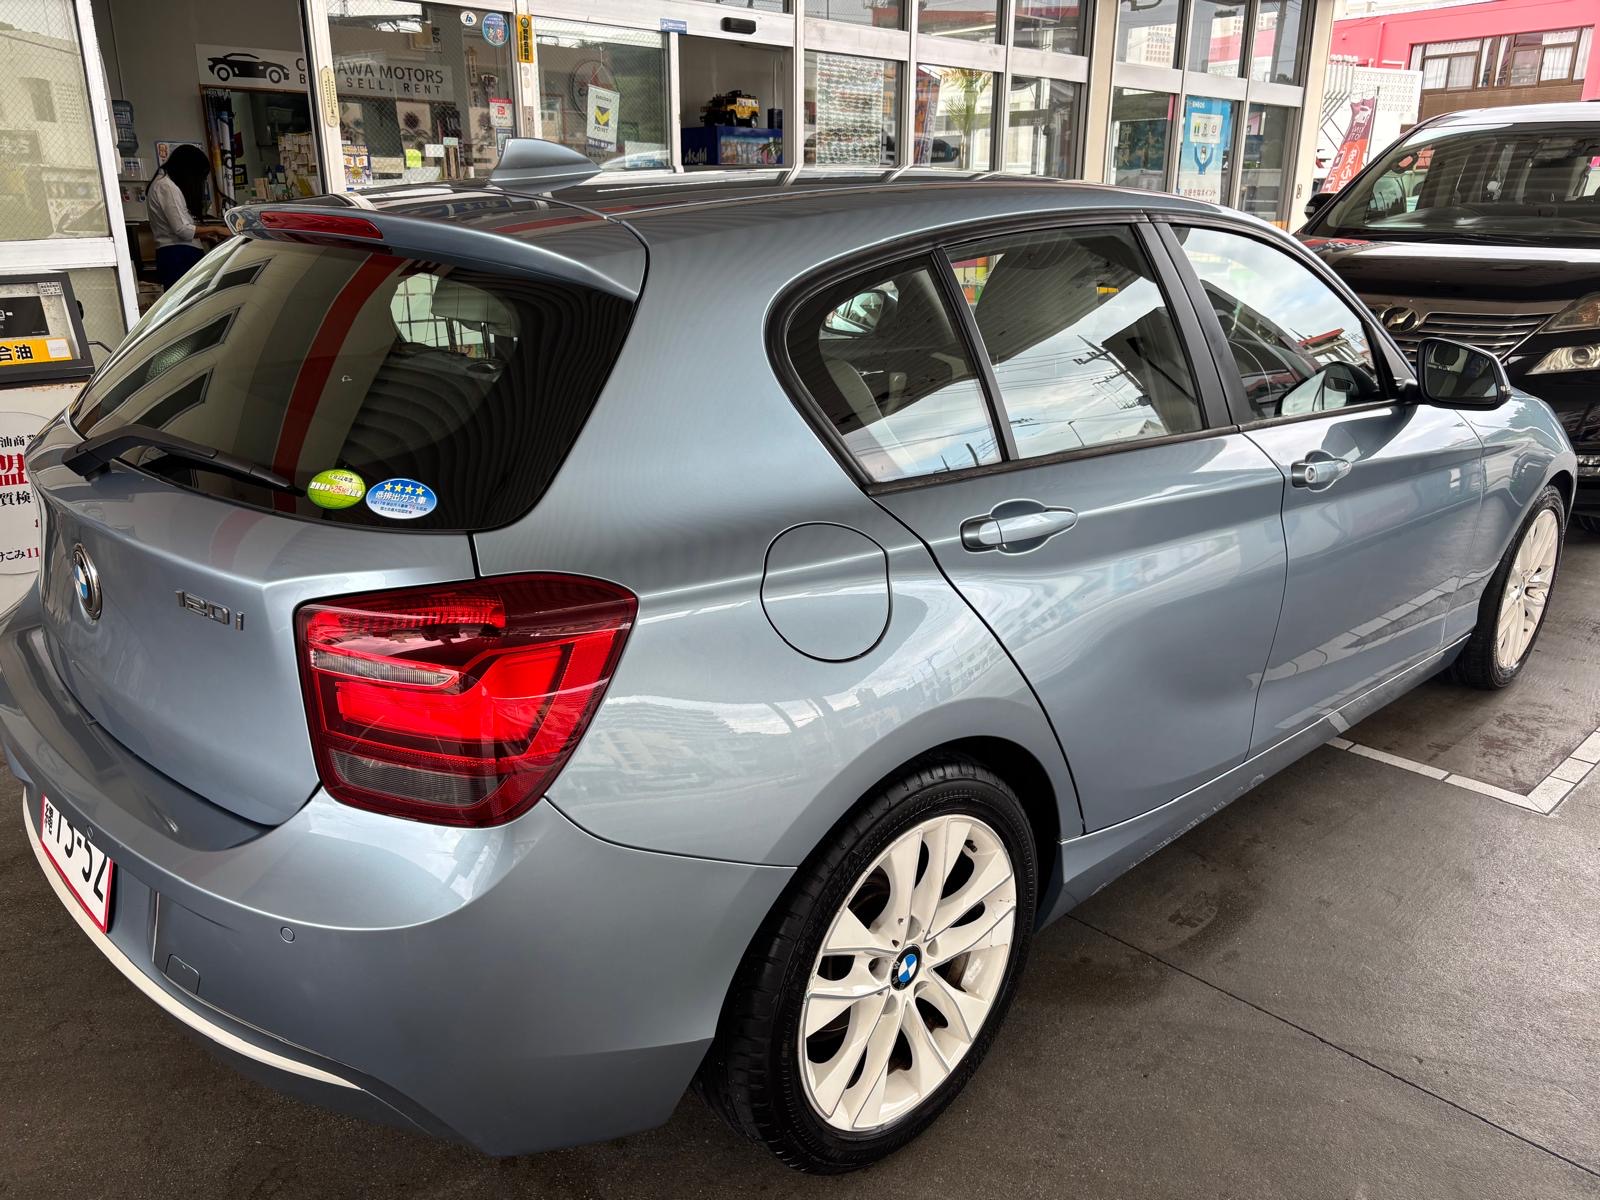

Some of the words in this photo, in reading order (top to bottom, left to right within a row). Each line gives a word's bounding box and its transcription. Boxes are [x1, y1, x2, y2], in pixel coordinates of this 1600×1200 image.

[379, 65, 444, 84] MOTORS
[403, 83, 441, 95] RENT
[0, 490, 34, 507] 質検
[375, 490, 427, 505] 低排出ガス車
[175, 589, 245, 631] 120i
